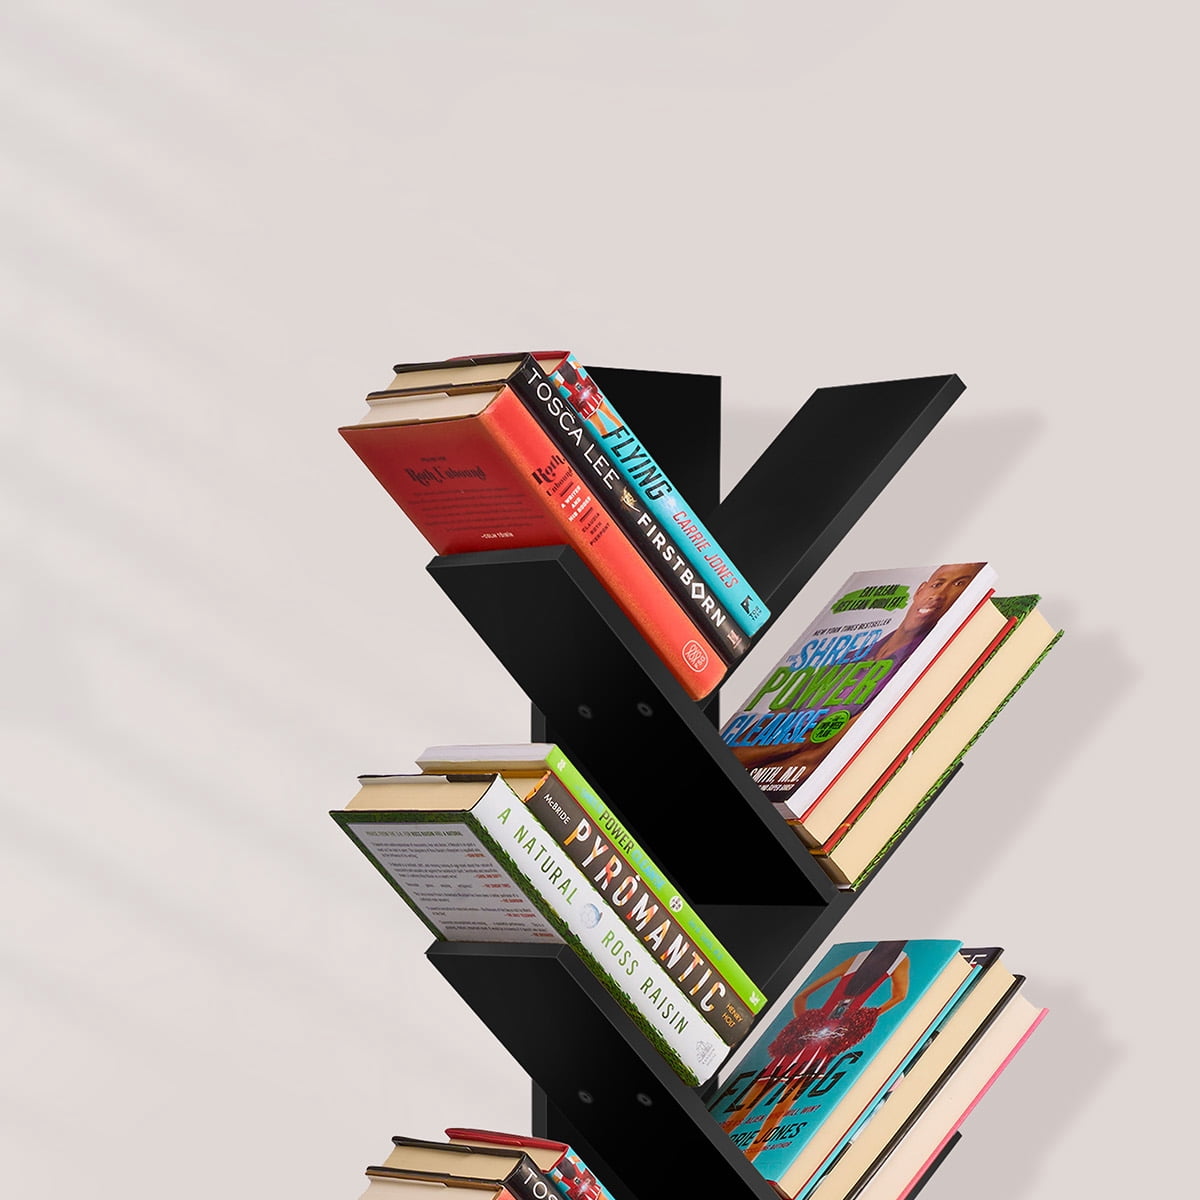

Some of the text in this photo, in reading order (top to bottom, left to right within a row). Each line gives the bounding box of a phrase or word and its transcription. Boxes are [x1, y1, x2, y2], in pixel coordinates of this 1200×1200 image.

[601, 425, 673, 501] FLYING
[528, 367, 727, 628] TOSCA LEE FIRSTBORN
[673, 511, 740, 590] CARRIE JONES
[789, 629, 883, 672] SHRED
[744, 659, 894, 711] POWER
[720, 708, 830, 747] CLEANSE
[599, 810, 635, 854] POWER
[497, 807, 689, 1034] A NATURAL ROSS RAISIN
[544, 793, 726, 1012] McBRIDE PYROMANTIC
[725, 1003, 744, 1023] HENRY
[753, 1122, 808, 1144] JONES
